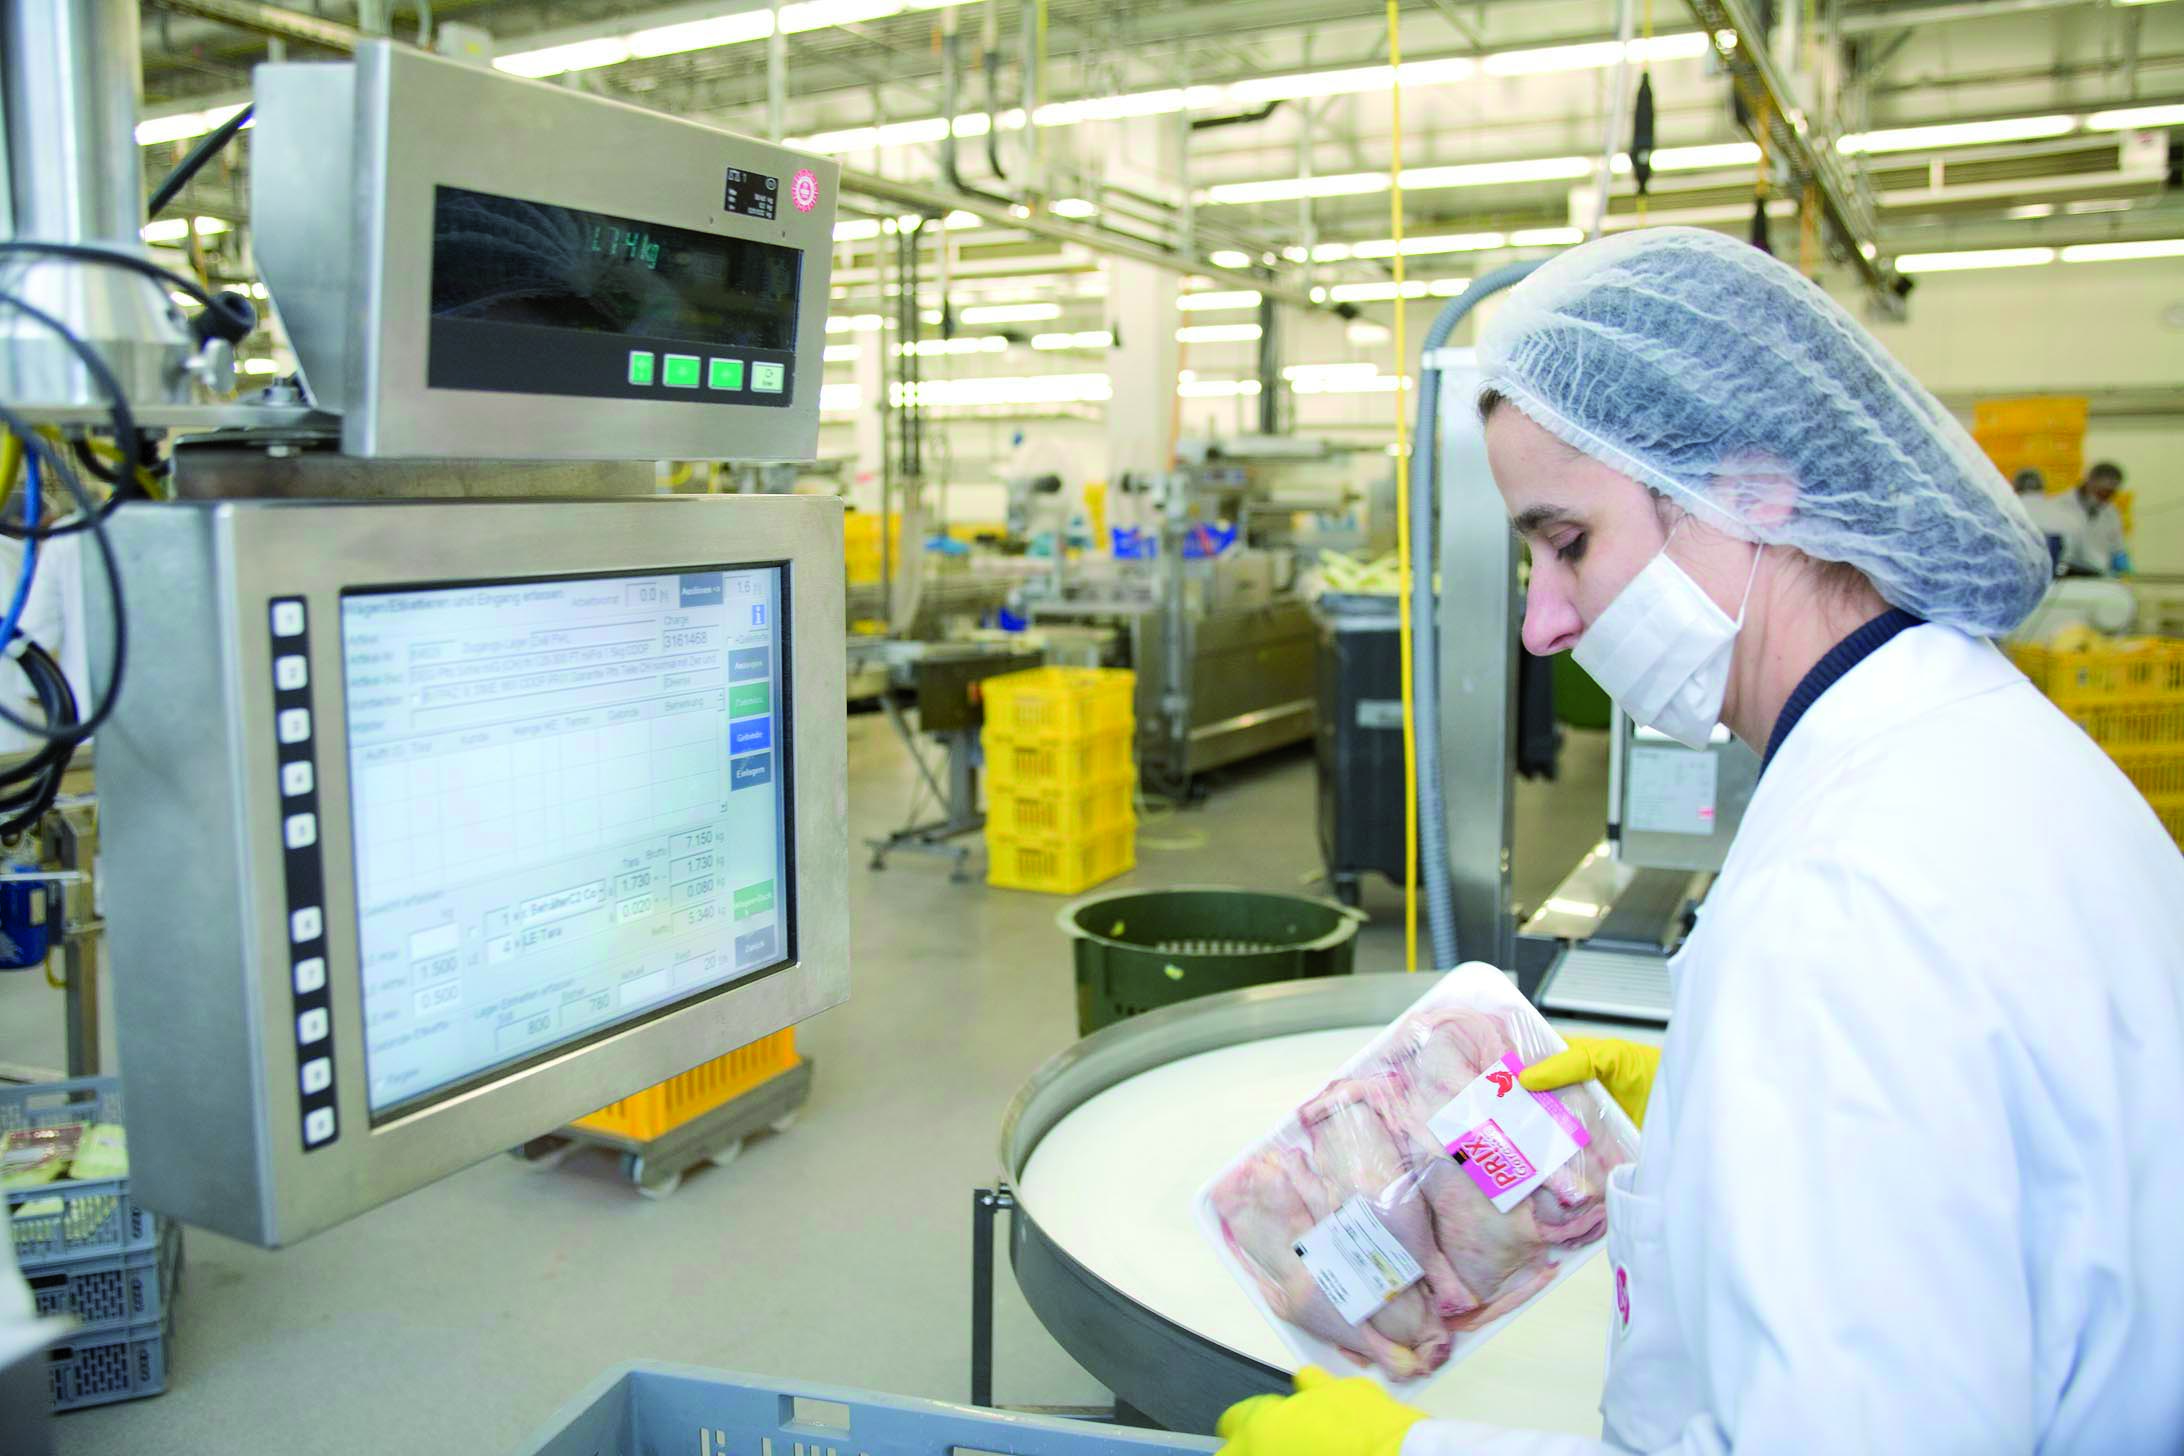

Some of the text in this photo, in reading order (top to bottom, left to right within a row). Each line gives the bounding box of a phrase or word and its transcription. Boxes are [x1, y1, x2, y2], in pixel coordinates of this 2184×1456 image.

[664, 631, 708, 648] 3161468
[686, 831, 712, 848] 7.150
[687, 855, 713, 872] 1.730
[622, 872, 651, 891] 1.730
[688, 904, 715, 925] 5.340
[419, 956, 459, 978] 1.500
[421, 986, 459, 1008] 0.500
[526, 1014, 551, 1035] 800
